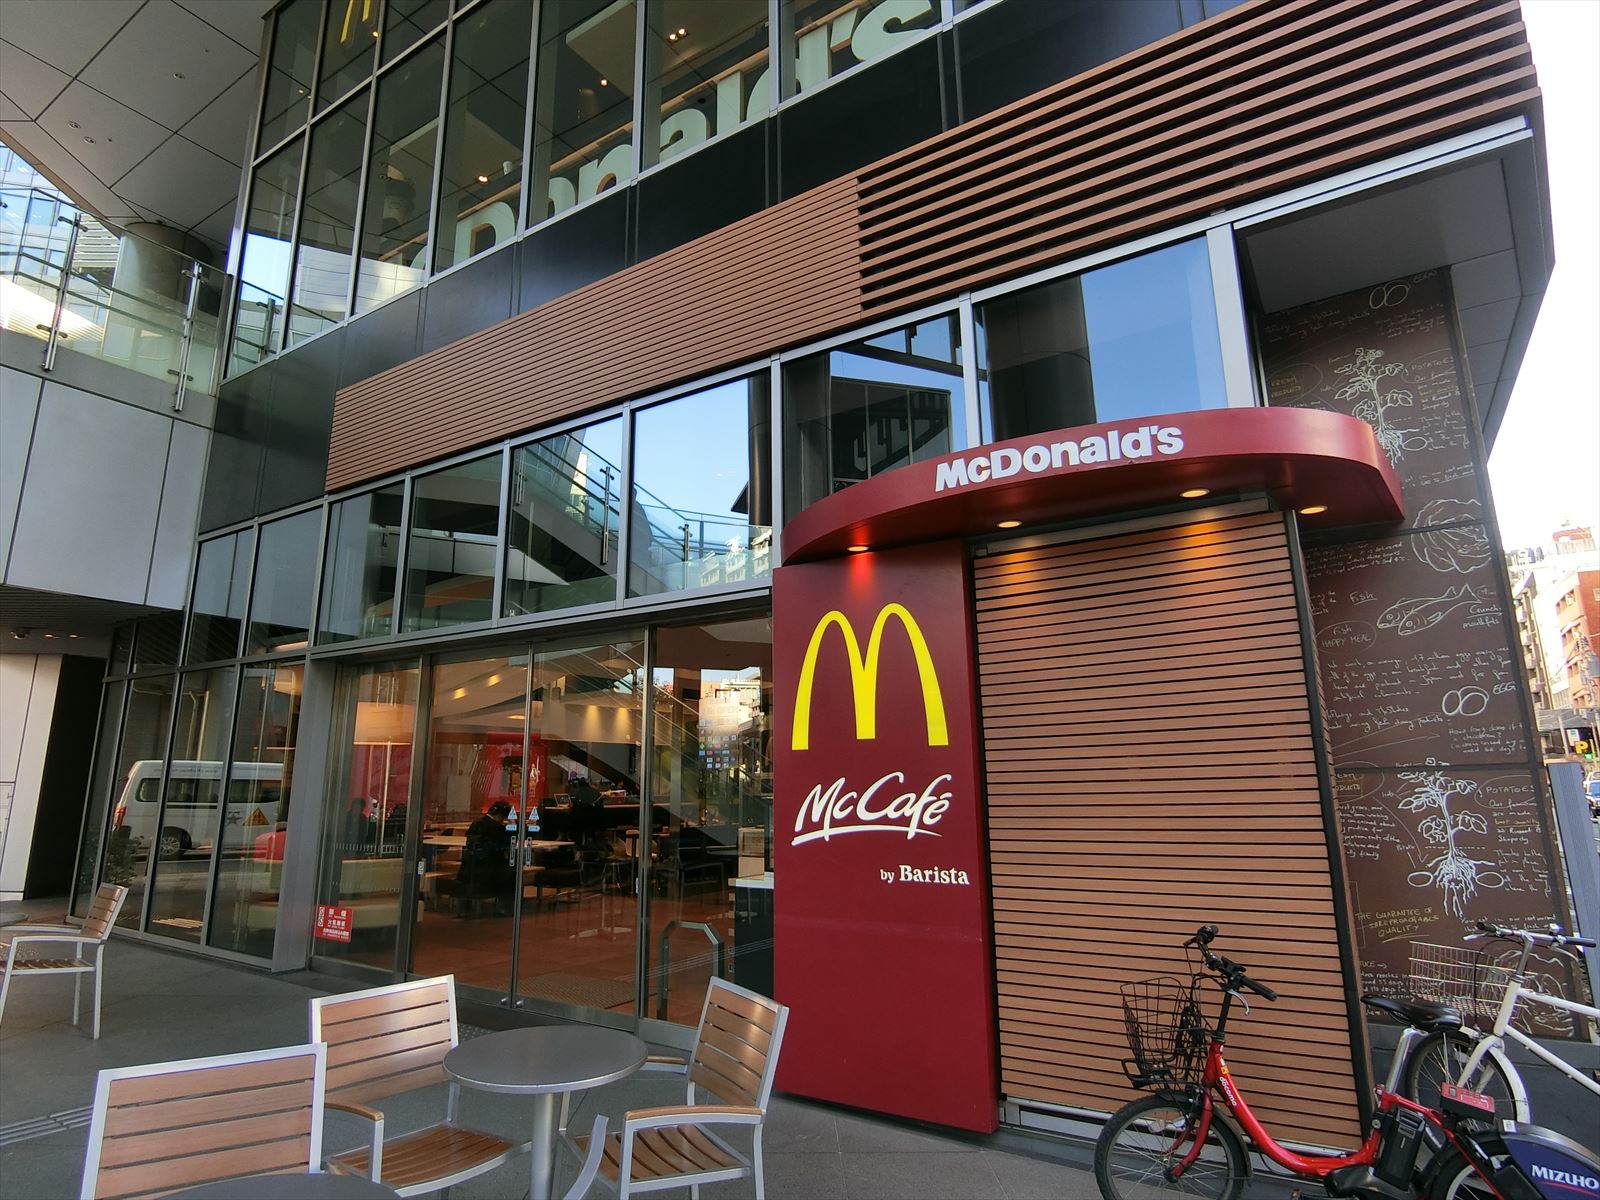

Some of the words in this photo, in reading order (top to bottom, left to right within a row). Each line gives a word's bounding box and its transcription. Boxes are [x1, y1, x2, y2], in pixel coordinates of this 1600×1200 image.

[935, 424, 1184, 492] McDonald's
[1575, 741, 1588, 754] P
[792, 771, 952, 846] McCafé
[880, 868, 895, 884] by
[899, 865, 970, 885] Barista
[1355, 912, 1371, 920] THE
[1378, 925, 1419, 937] QUALITY
[1219, 1076, 1237, 1107] docomo
[1532, 1164, 1599, 1191] MIZUHO
